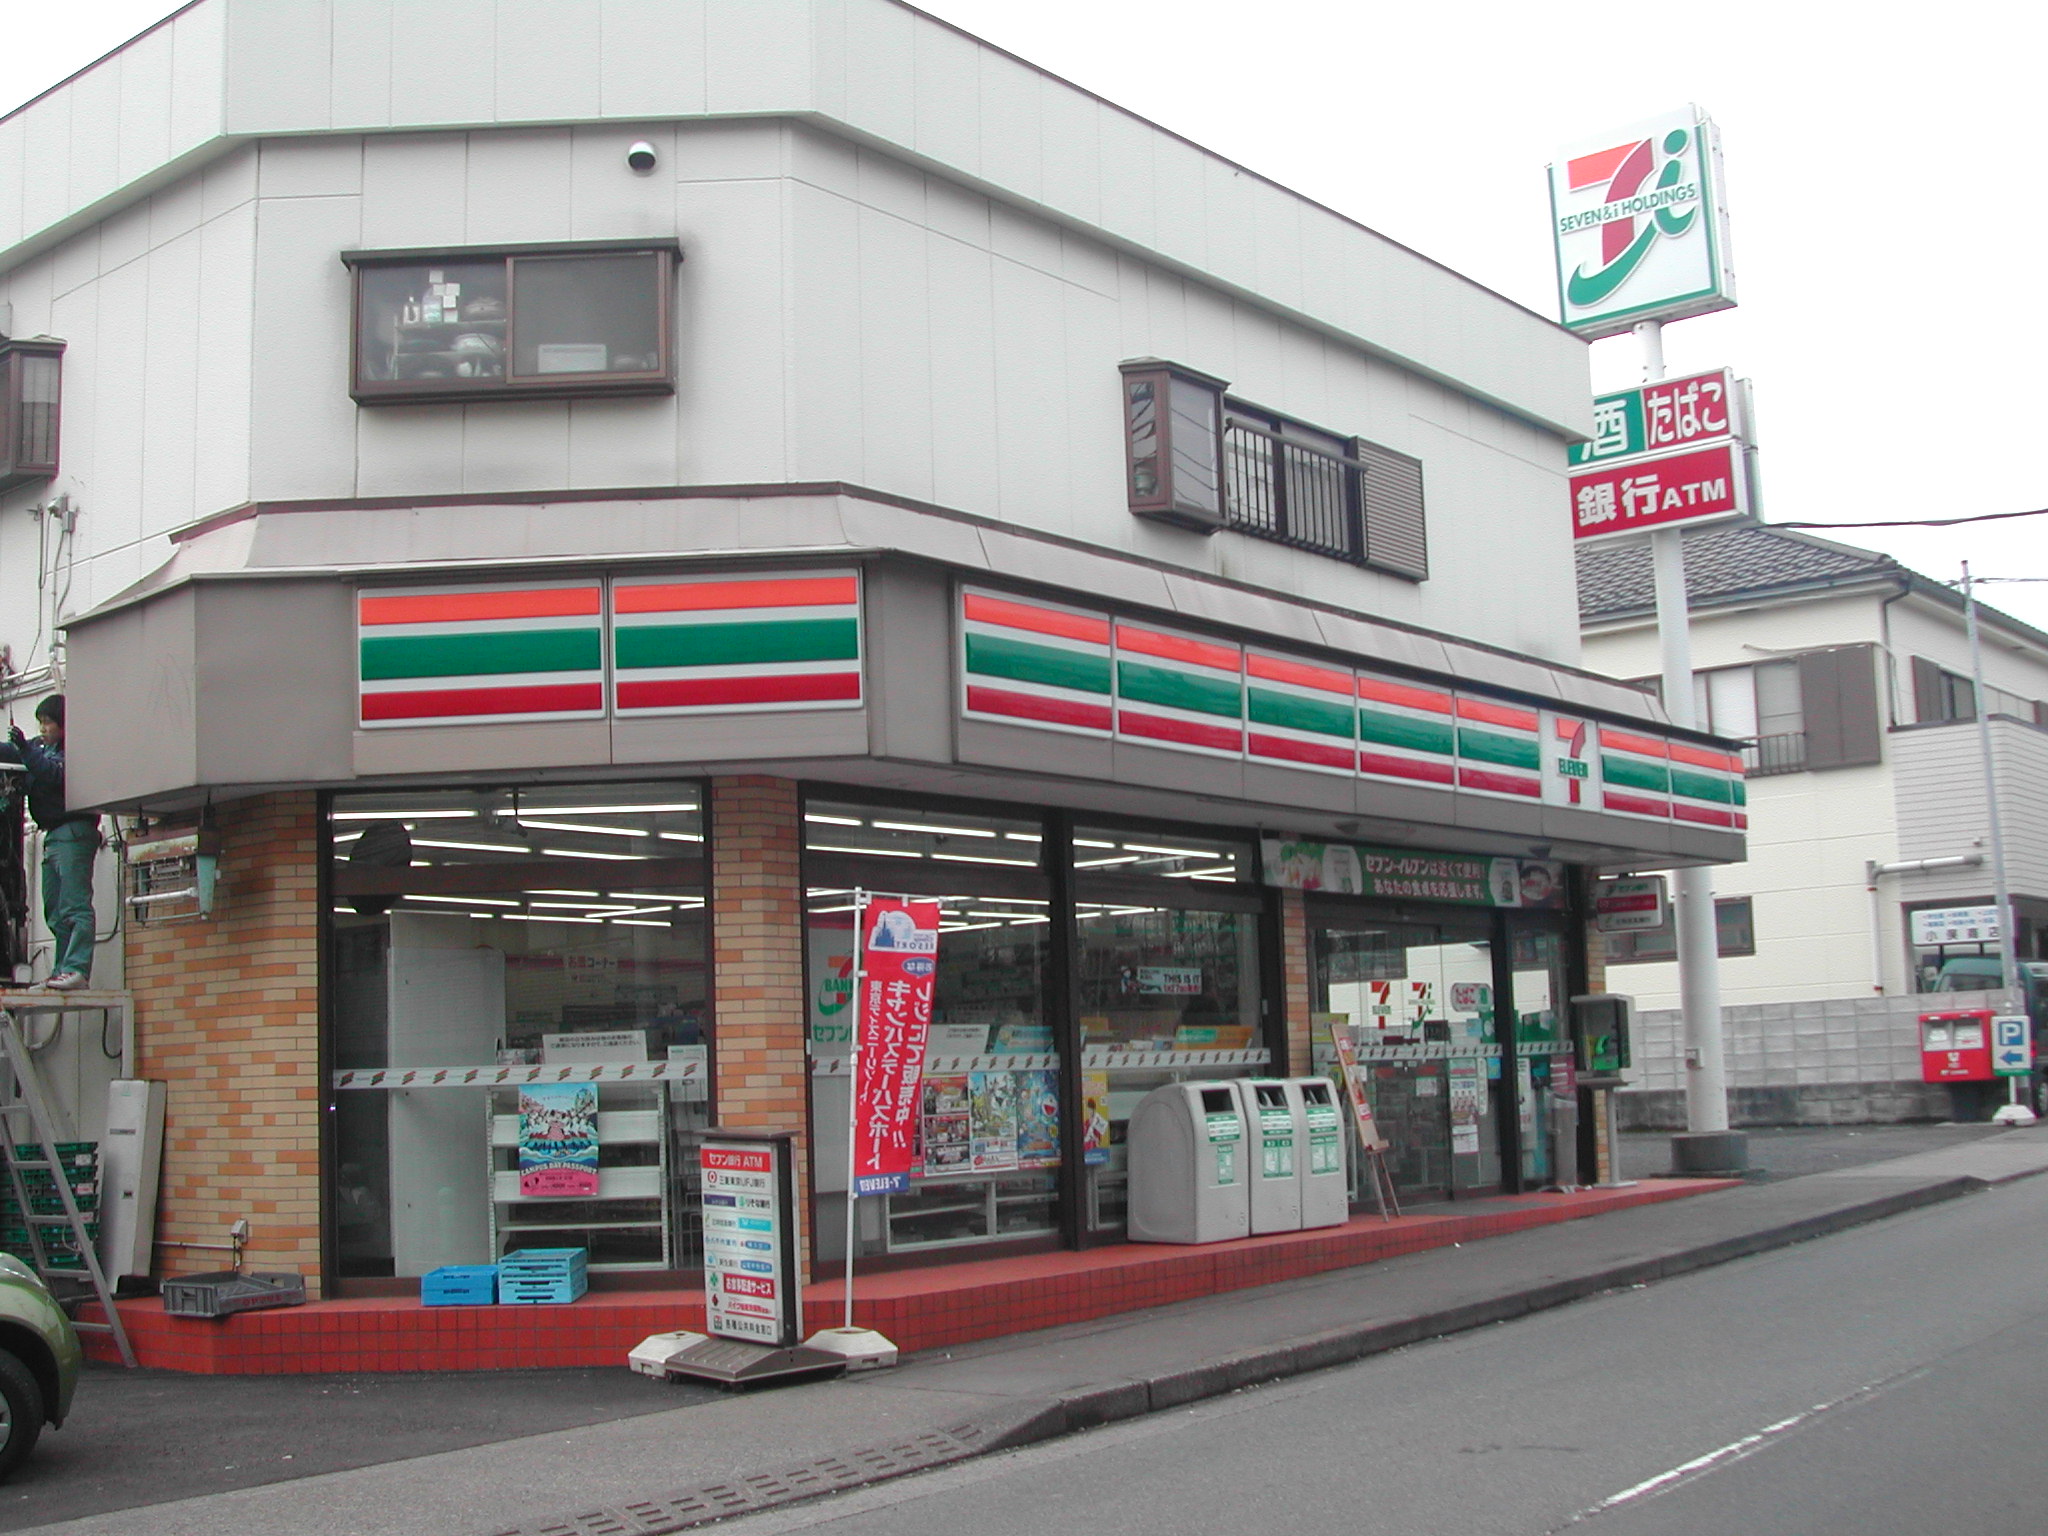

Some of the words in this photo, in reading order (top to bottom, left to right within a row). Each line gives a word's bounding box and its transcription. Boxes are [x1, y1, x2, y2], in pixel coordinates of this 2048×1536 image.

[1621, 183, 1697, 216] HOLDINGS
[1647, 381, 1728, 449] たばこ
[1576, 473, 1661, 527] 銀行
[1662, 477, 1727, 511] ATM
[2002, 1023, 2021, 1045] P
[743, 1155, 764, 1169] ATM
